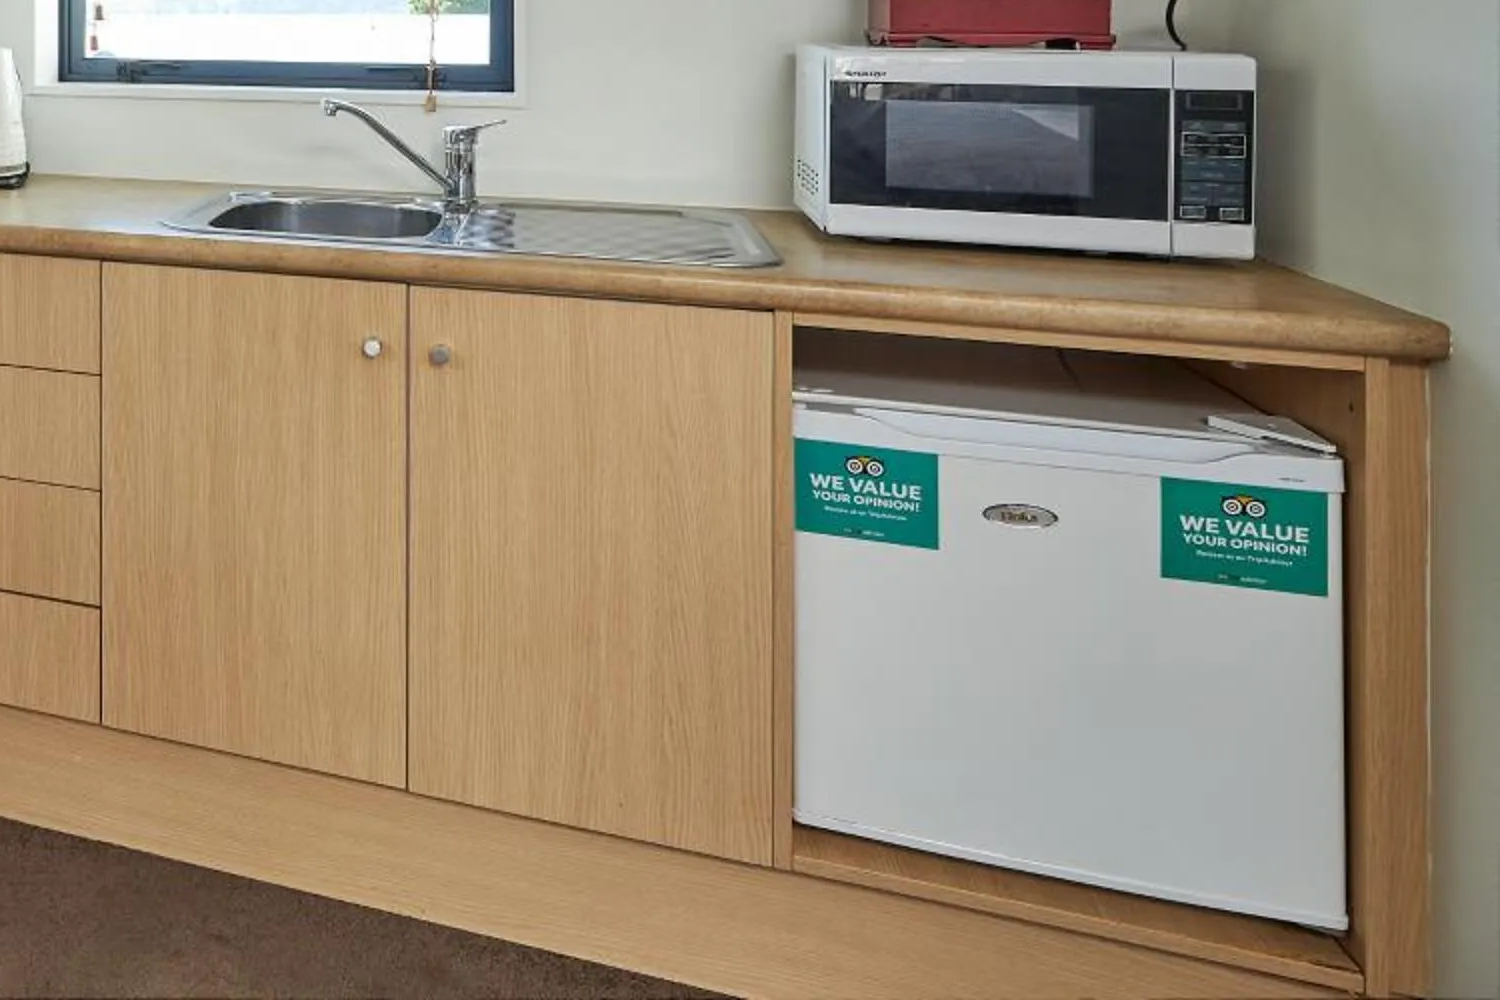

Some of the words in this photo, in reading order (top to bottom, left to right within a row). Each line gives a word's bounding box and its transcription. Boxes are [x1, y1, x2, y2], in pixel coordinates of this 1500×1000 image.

[810, 473, 845, 491] WE
[849, 478, 922, 500] VALUE
[812, 490, 851, 504] YOUR
[853, 495, 920, 512] OPINION!
[1180, 514, 1220, 534] WE
[1225, 519, 1309, 543] VALUE
[1183, 533, 1227, 547] YOUR
[1230, 539, 1307, 557] OPINION!
